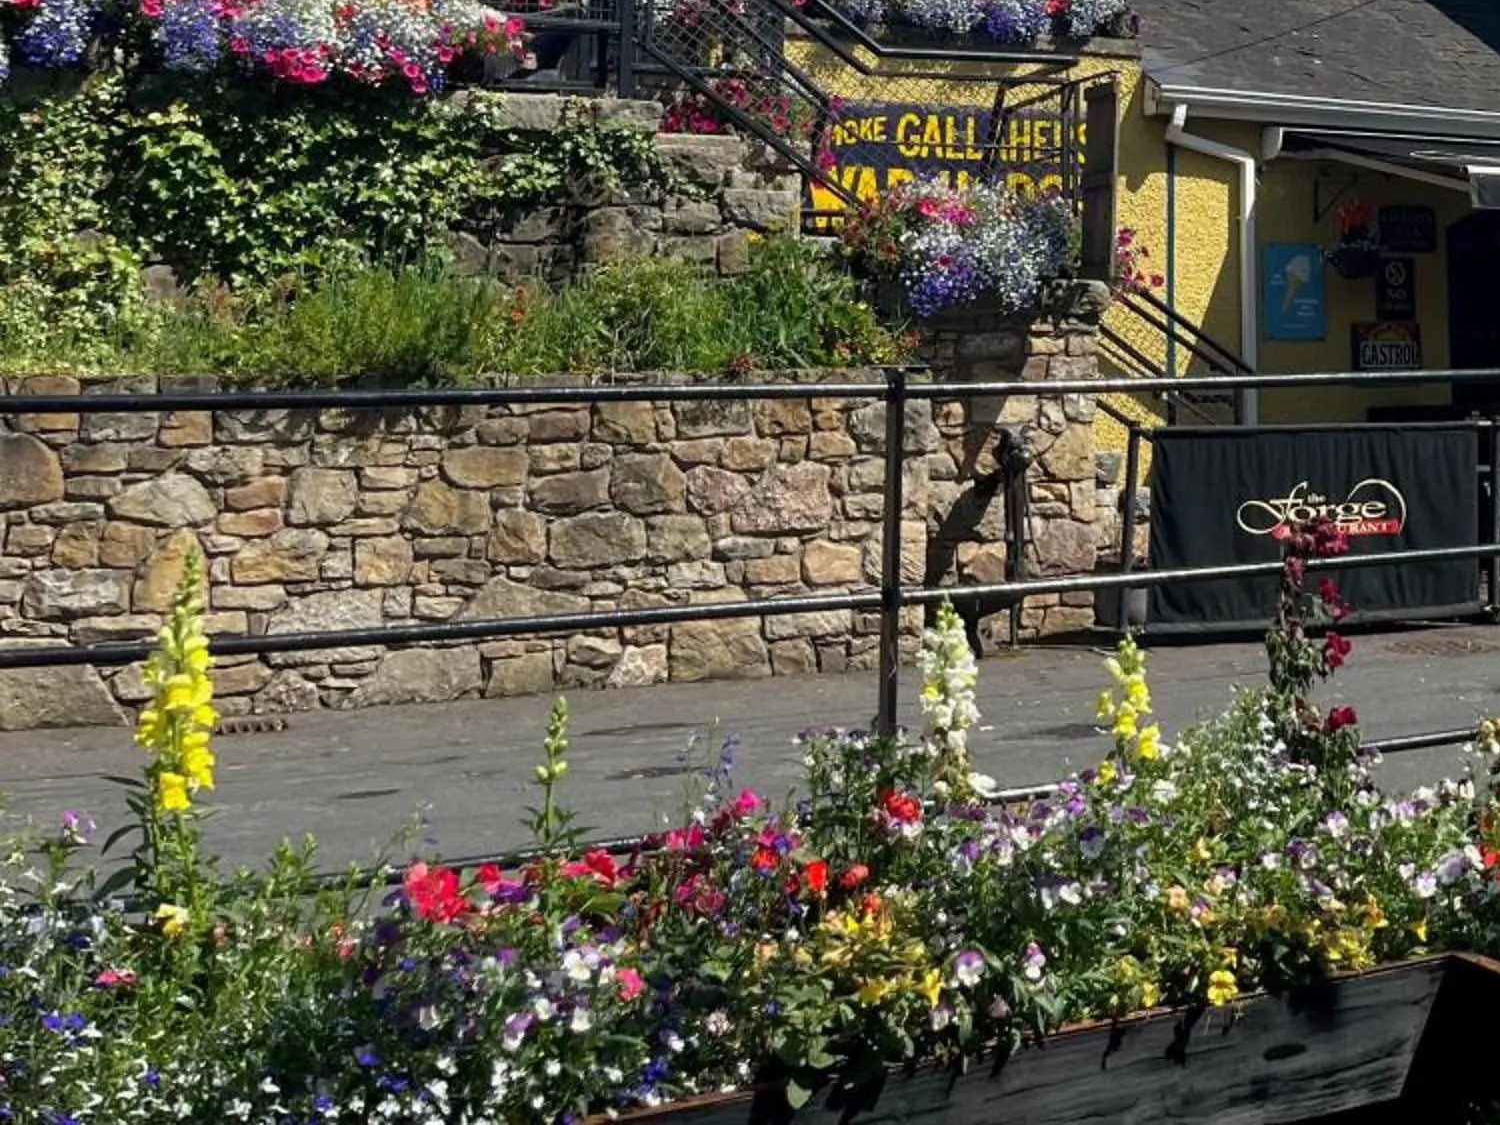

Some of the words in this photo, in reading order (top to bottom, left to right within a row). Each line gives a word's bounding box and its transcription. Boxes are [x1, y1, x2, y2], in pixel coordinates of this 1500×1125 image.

[1361, 343, 1418, 365] CASTROL
[1237, 479, 1407, 535] Forge
[1307, 493, 1326, 503] the
